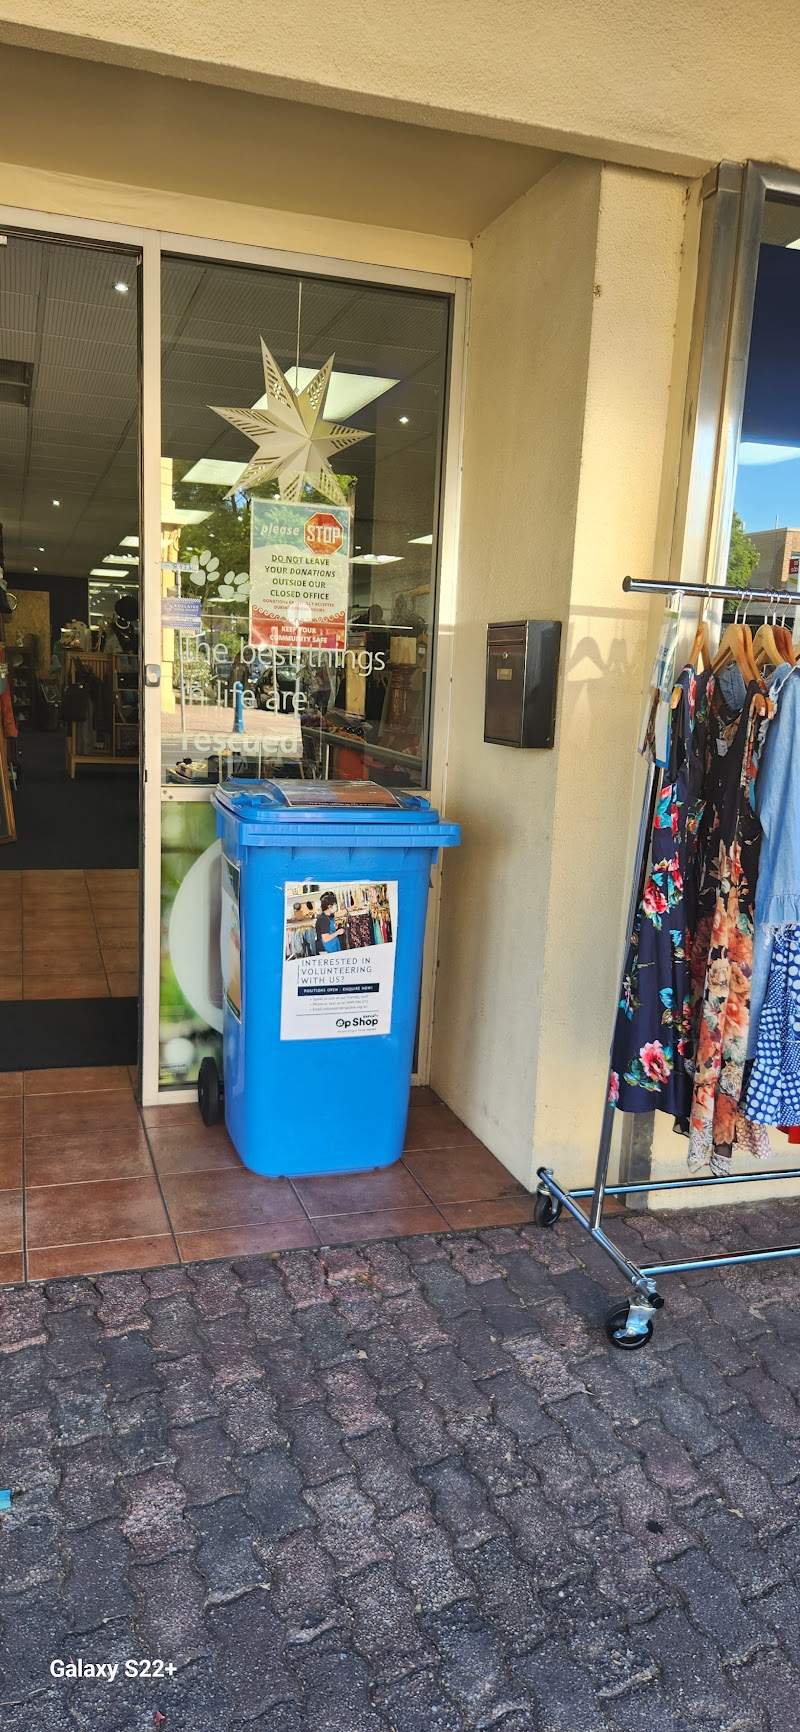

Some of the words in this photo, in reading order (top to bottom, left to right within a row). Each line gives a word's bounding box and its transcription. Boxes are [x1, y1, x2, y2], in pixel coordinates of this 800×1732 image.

[261, 523, 300, 536] please
[306, 525, 341, 544] STOP
[271, 554, 283, 562] DO
[286, 555, 303, 563] NOT
[305, 557, 330, 566] LEAVE
[264, 565, 288, 575] YOUR
[290, 568, 336, 578] DONATIONS
[272, 578, 307, 587] OUTSIDE
[308, 580, 326, 589] OUR
[270, 589, 301, 598] CLOSED
[302, 591, 330, 600] OFFICE
[312, 636, 328, 644] SAFE
[240, 637, 298, 667] best
[308, 642, 386, 676] things
[216, 679, 256, 709] life
[265, 691, 308, 711] are
[181, 729, 298, 753] rescued
[302, 958, 358, 966] INTERESTED
[301, 966, 373, 976] VOLUNTEERING
[329, 976, 345, 984] US?
[335, 1019, 351, 1028] Op
[352, 1018, 379, 1027] Shop
